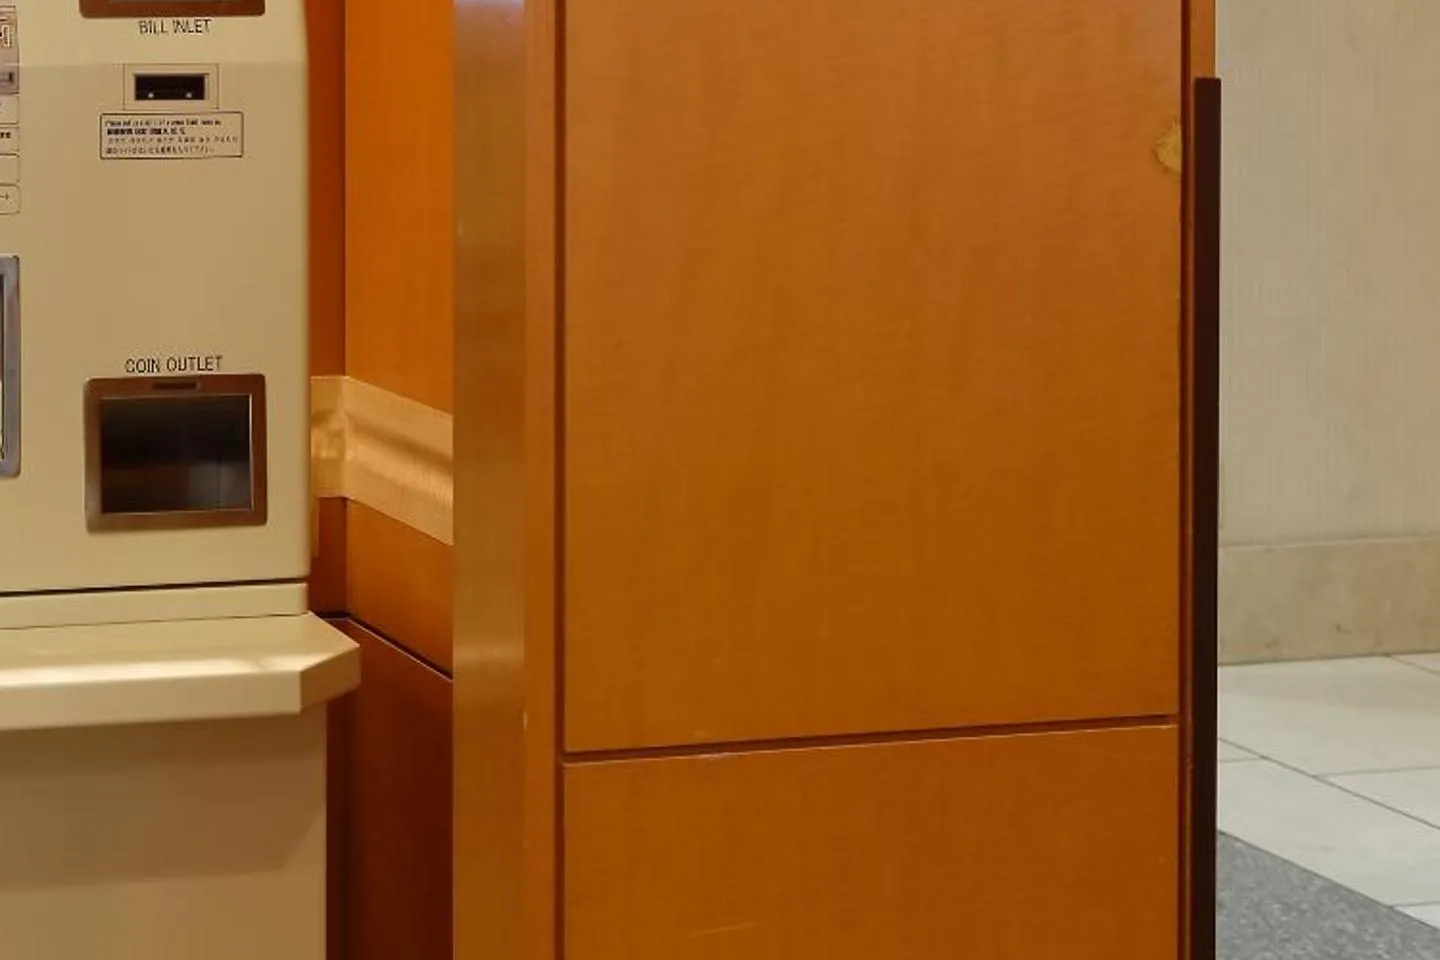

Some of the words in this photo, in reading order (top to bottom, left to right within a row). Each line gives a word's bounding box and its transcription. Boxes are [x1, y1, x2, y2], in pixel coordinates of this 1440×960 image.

[139, 20, 168, 35] BILL
[172, 18, 212, 34] INLET
[124, 357, 160, 374] COIN
[166, 355, 224, 372] OUTLET
